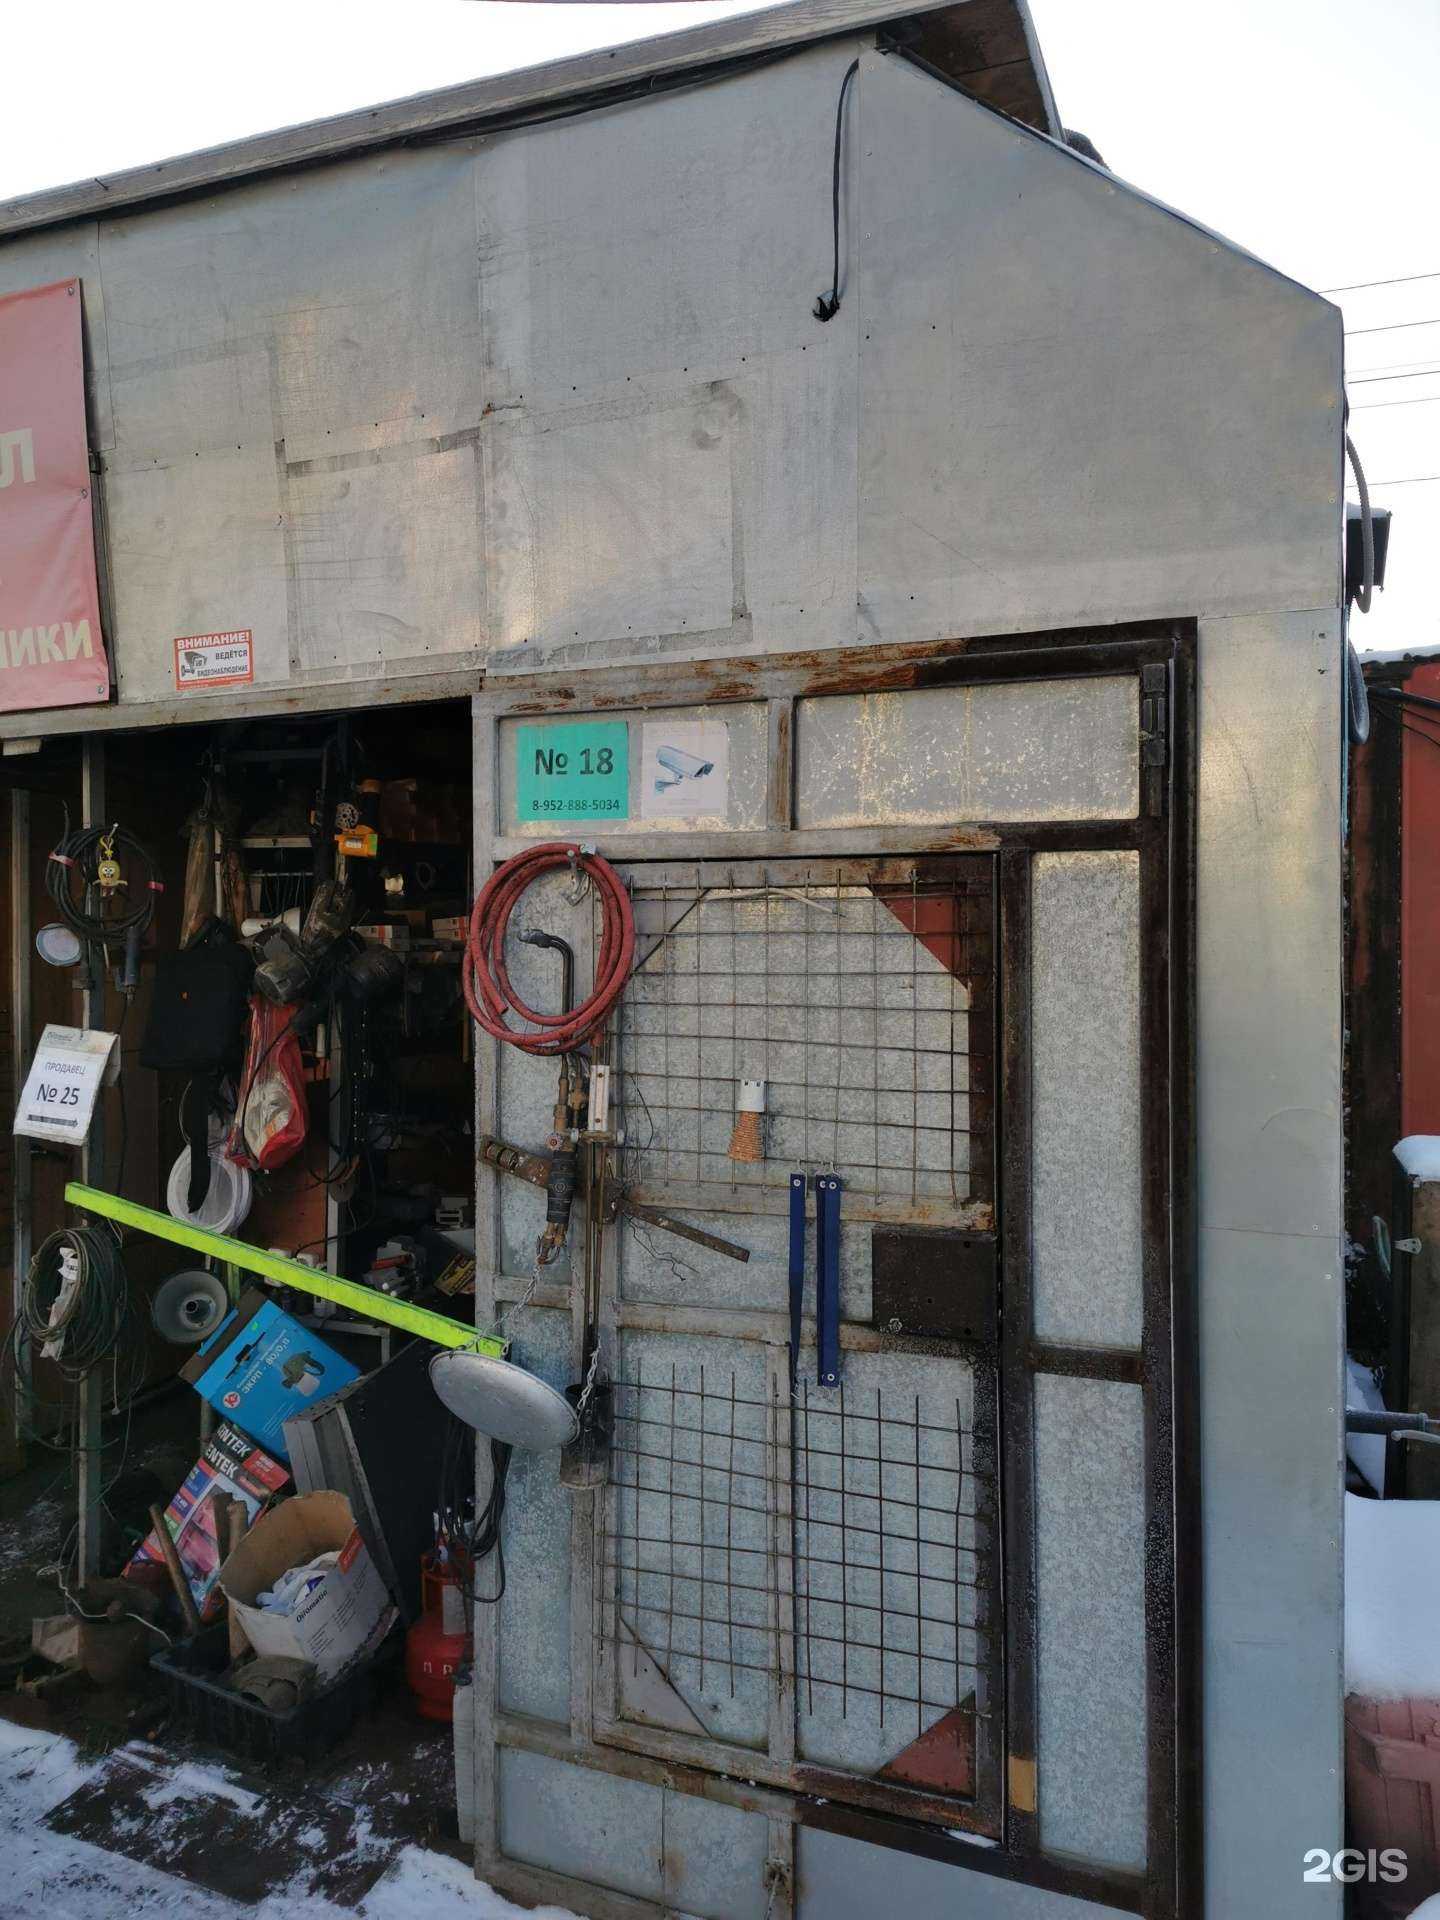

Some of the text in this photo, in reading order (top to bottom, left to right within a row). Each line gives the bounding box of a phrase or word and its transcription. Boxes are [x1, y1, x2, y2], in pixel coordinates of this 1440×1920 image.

[177, 631, 249, 651] ВНИМАНИЕ!
[535, 748, 614, 775] № 18
[532, 799, 620, 811] 8-952-888-5034
[45, 1061, 86, 1076] ПРОДАВЕЦ
[37, 1083, 80, 1106] № 25
